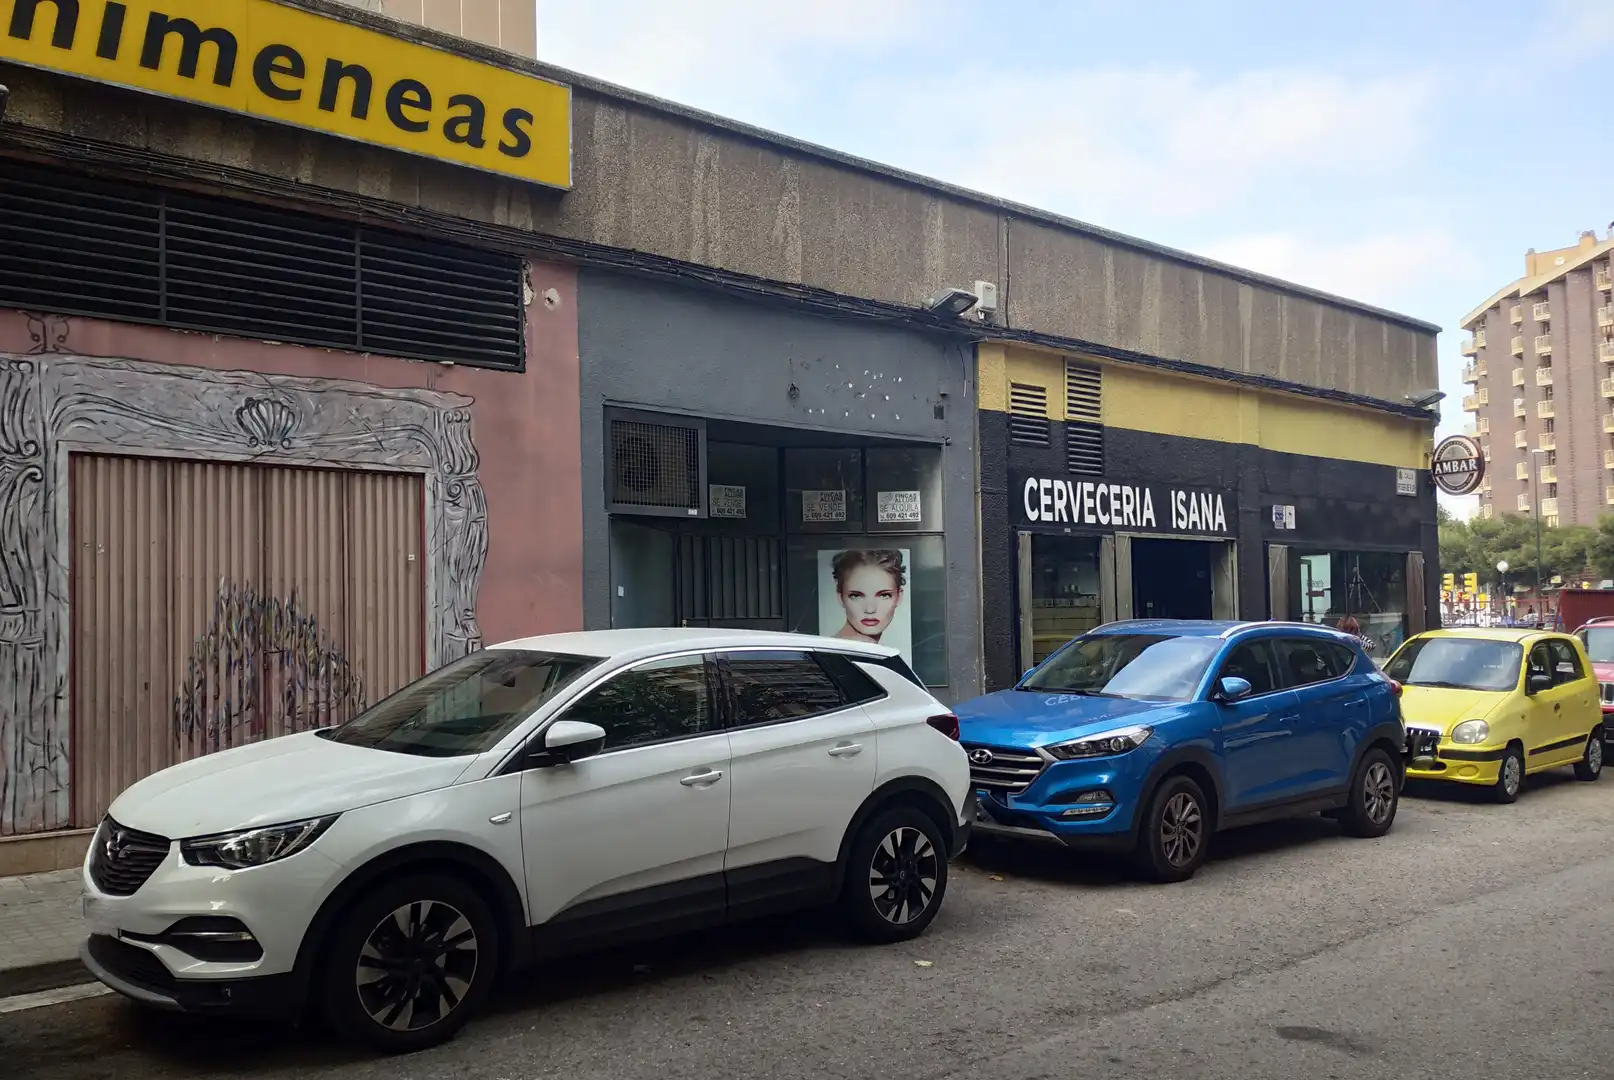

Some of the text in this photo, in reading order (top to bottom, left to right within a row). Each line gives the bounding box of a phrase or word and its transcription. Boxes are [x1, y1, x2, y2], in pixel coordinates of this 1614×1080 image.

[1434, 458, 1478, 475] AMBAR
[806, 503, 844, 511] SE VENDE
[879, 503, 919, 512] SE ALQUILA
[1023, 476, 1157, 528] CERVECERIA
[1171, 489, 1228, 532] ISANA
